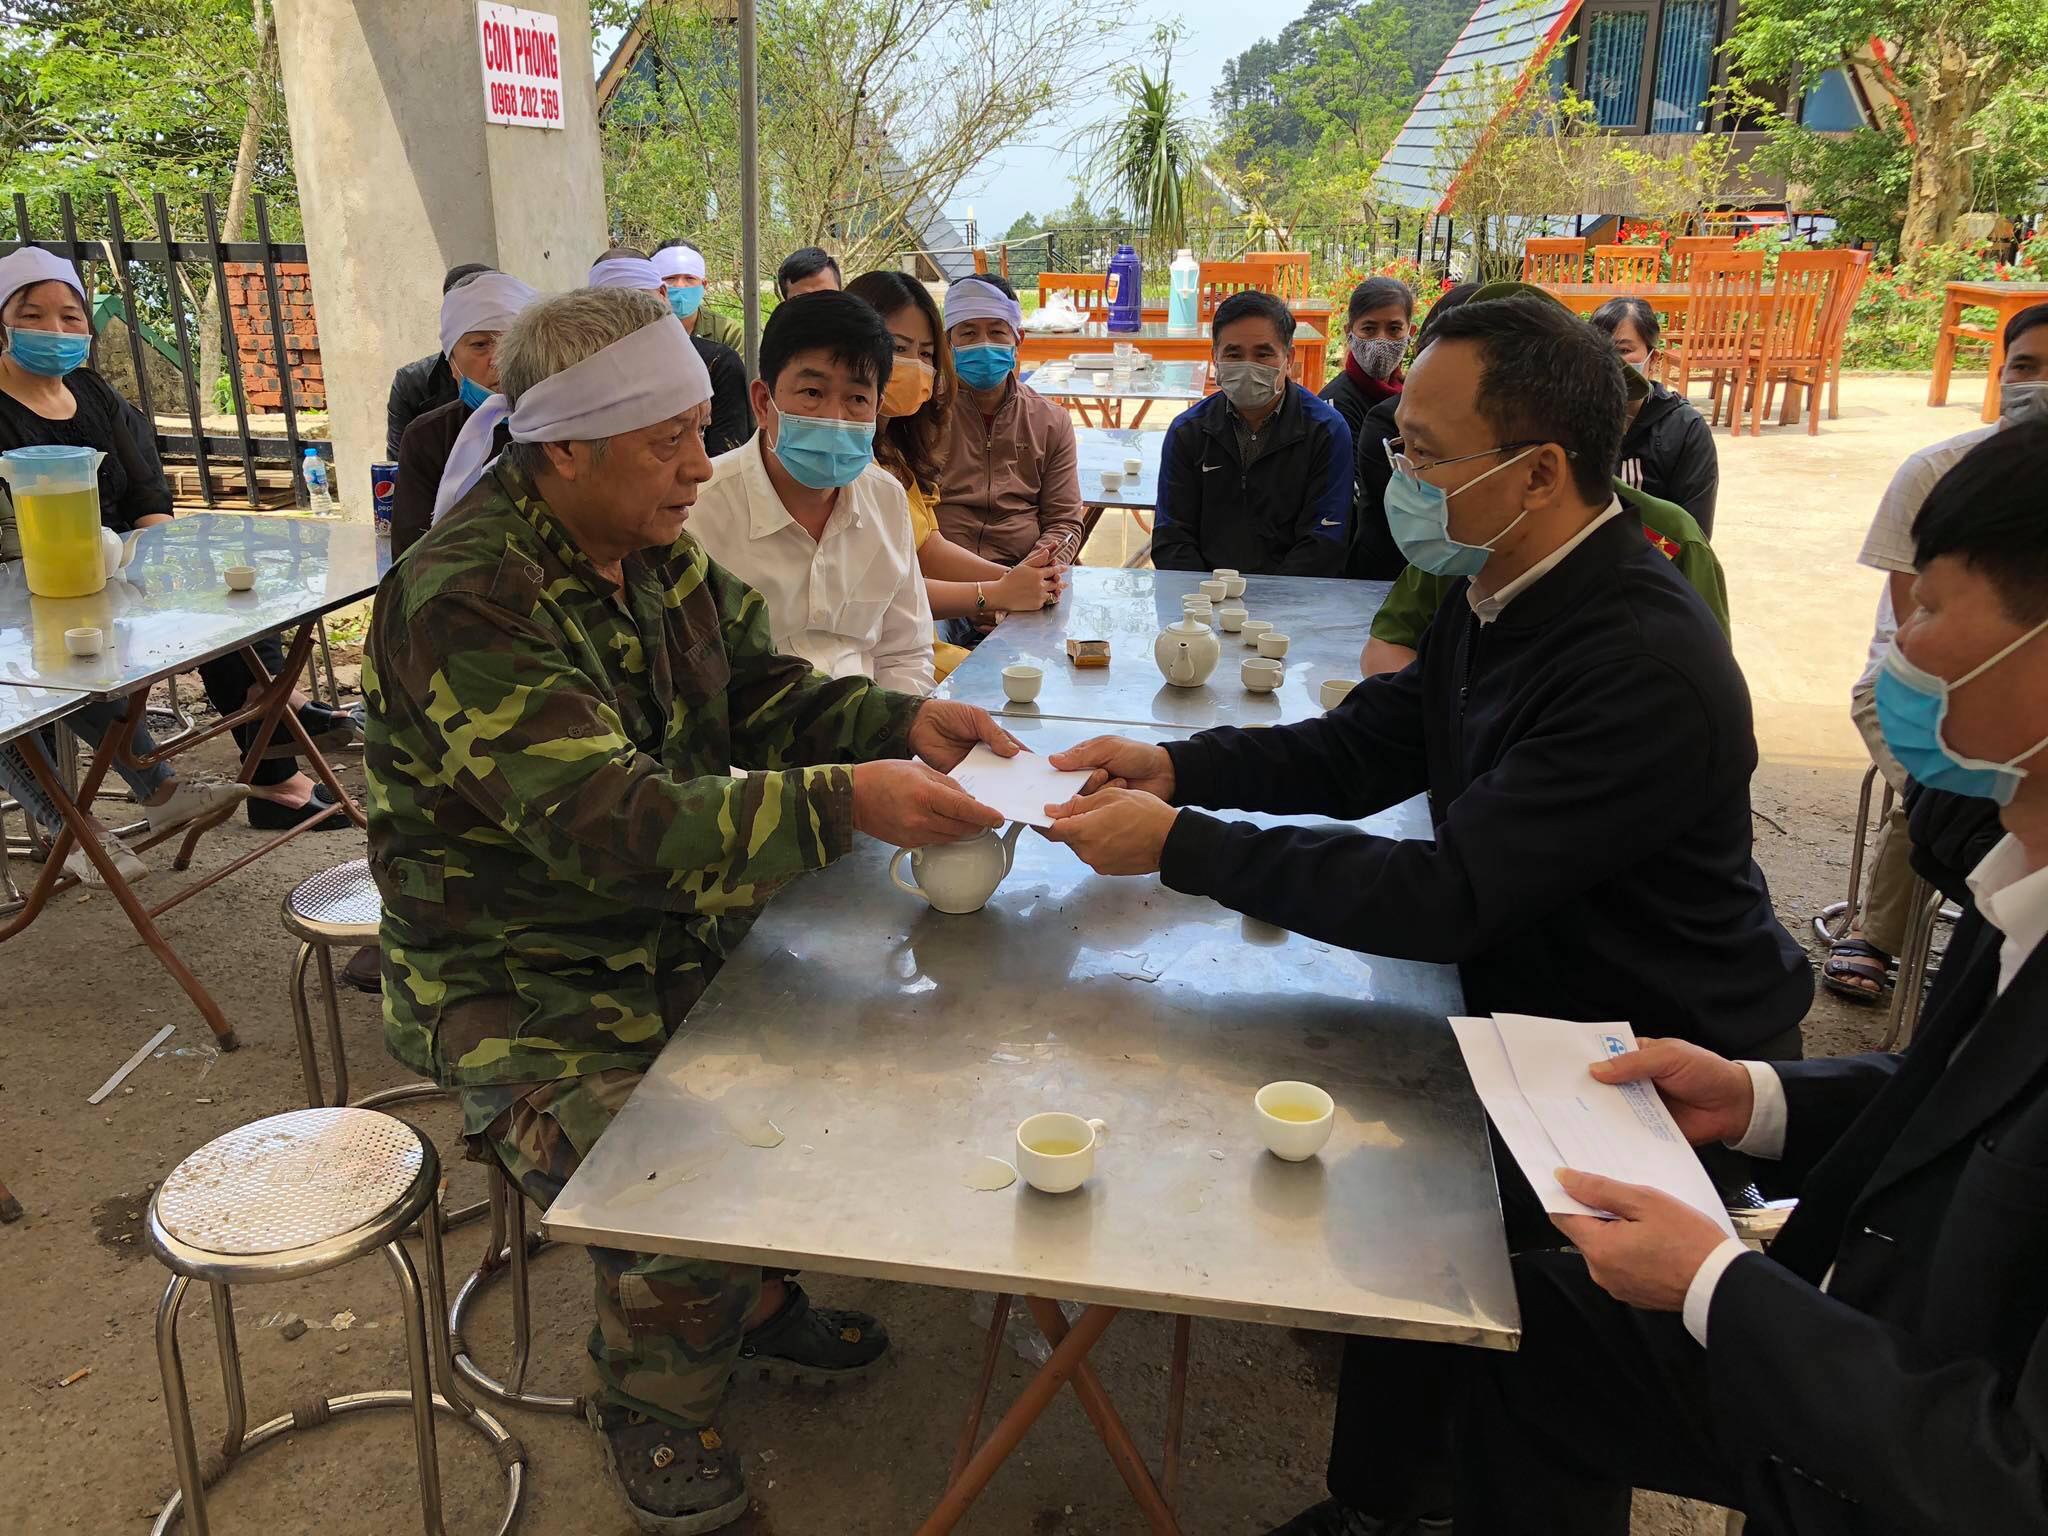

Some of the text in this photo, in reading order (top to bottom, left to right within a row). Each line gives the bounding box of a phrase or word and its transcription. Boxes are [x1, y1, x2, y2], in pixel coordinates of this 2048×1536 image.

[483, 11, 559, 79] CÒN PHÒNG
[491, 81, 560, 120] 0968 202 569
